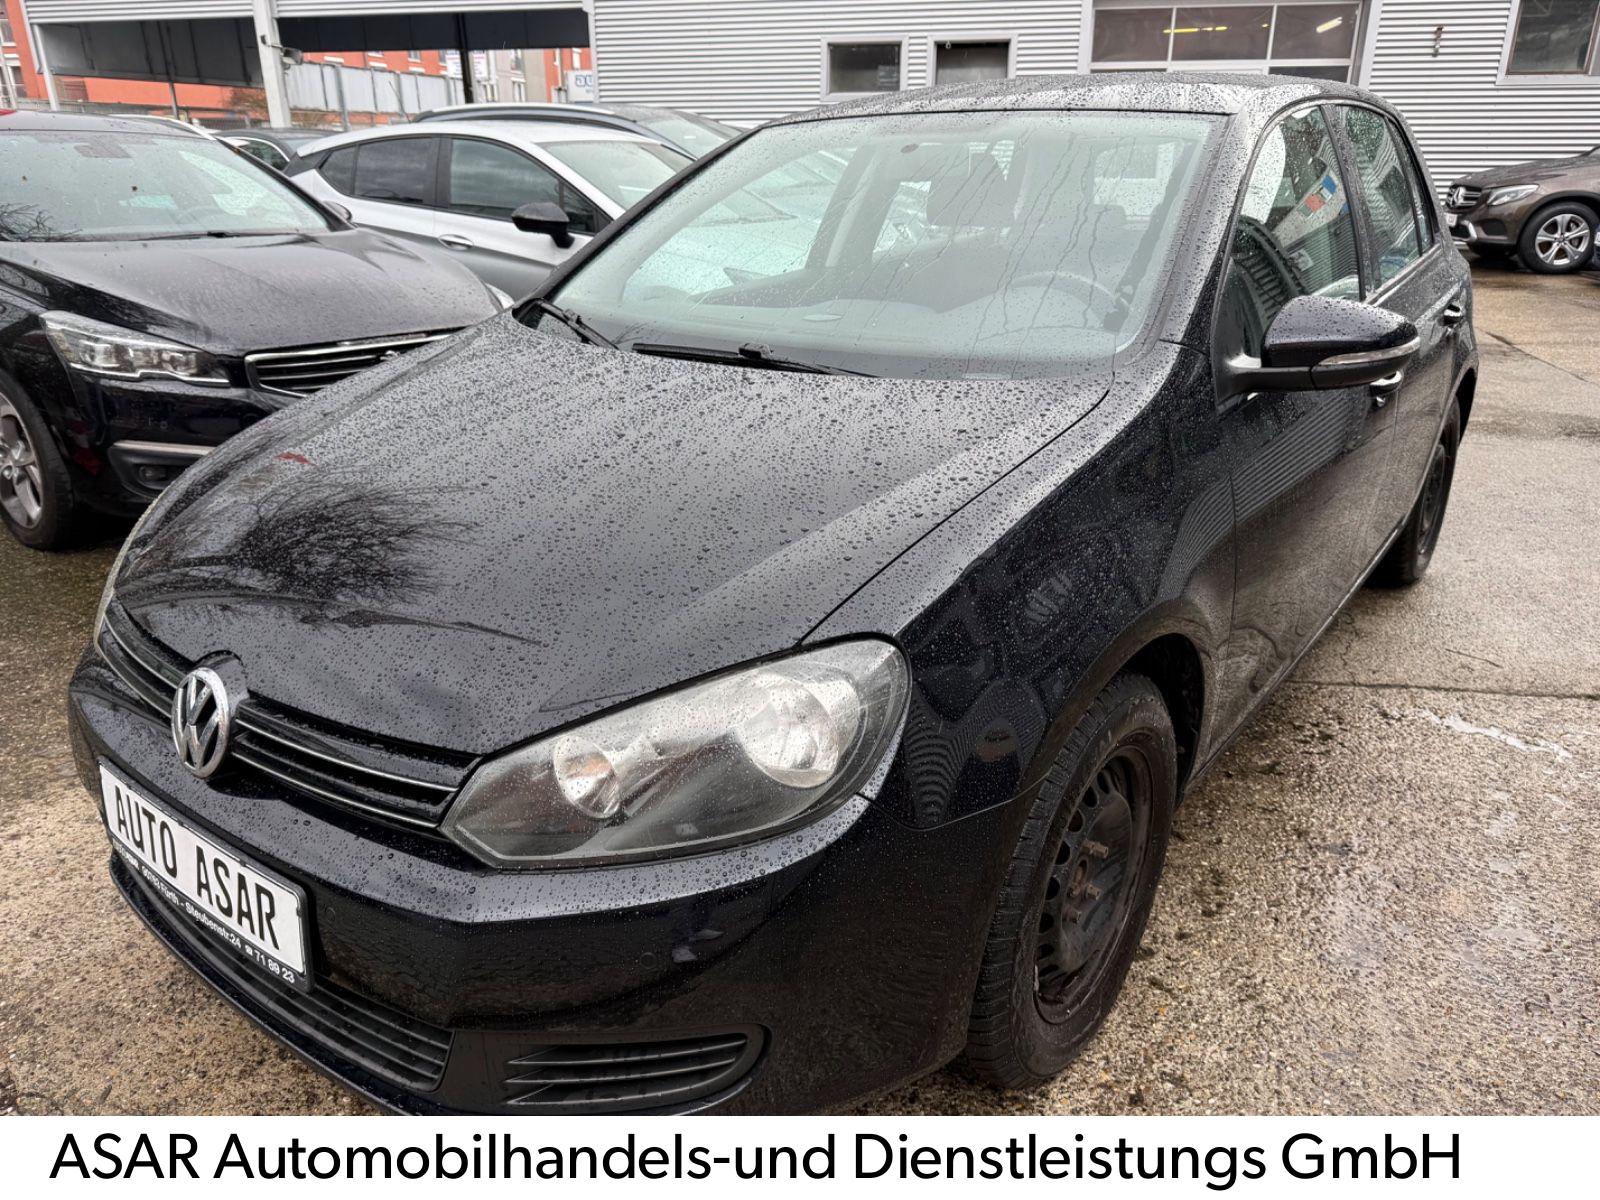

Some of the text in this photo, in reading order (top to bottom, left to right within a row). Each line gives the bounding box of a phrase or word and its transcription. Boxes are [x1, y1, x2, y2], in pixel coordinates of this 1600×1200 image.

[115, 785, 280, 950] AUTO ASAR
[254, 949, 267, 966] 71
[281, 967, 295, 984] 23
